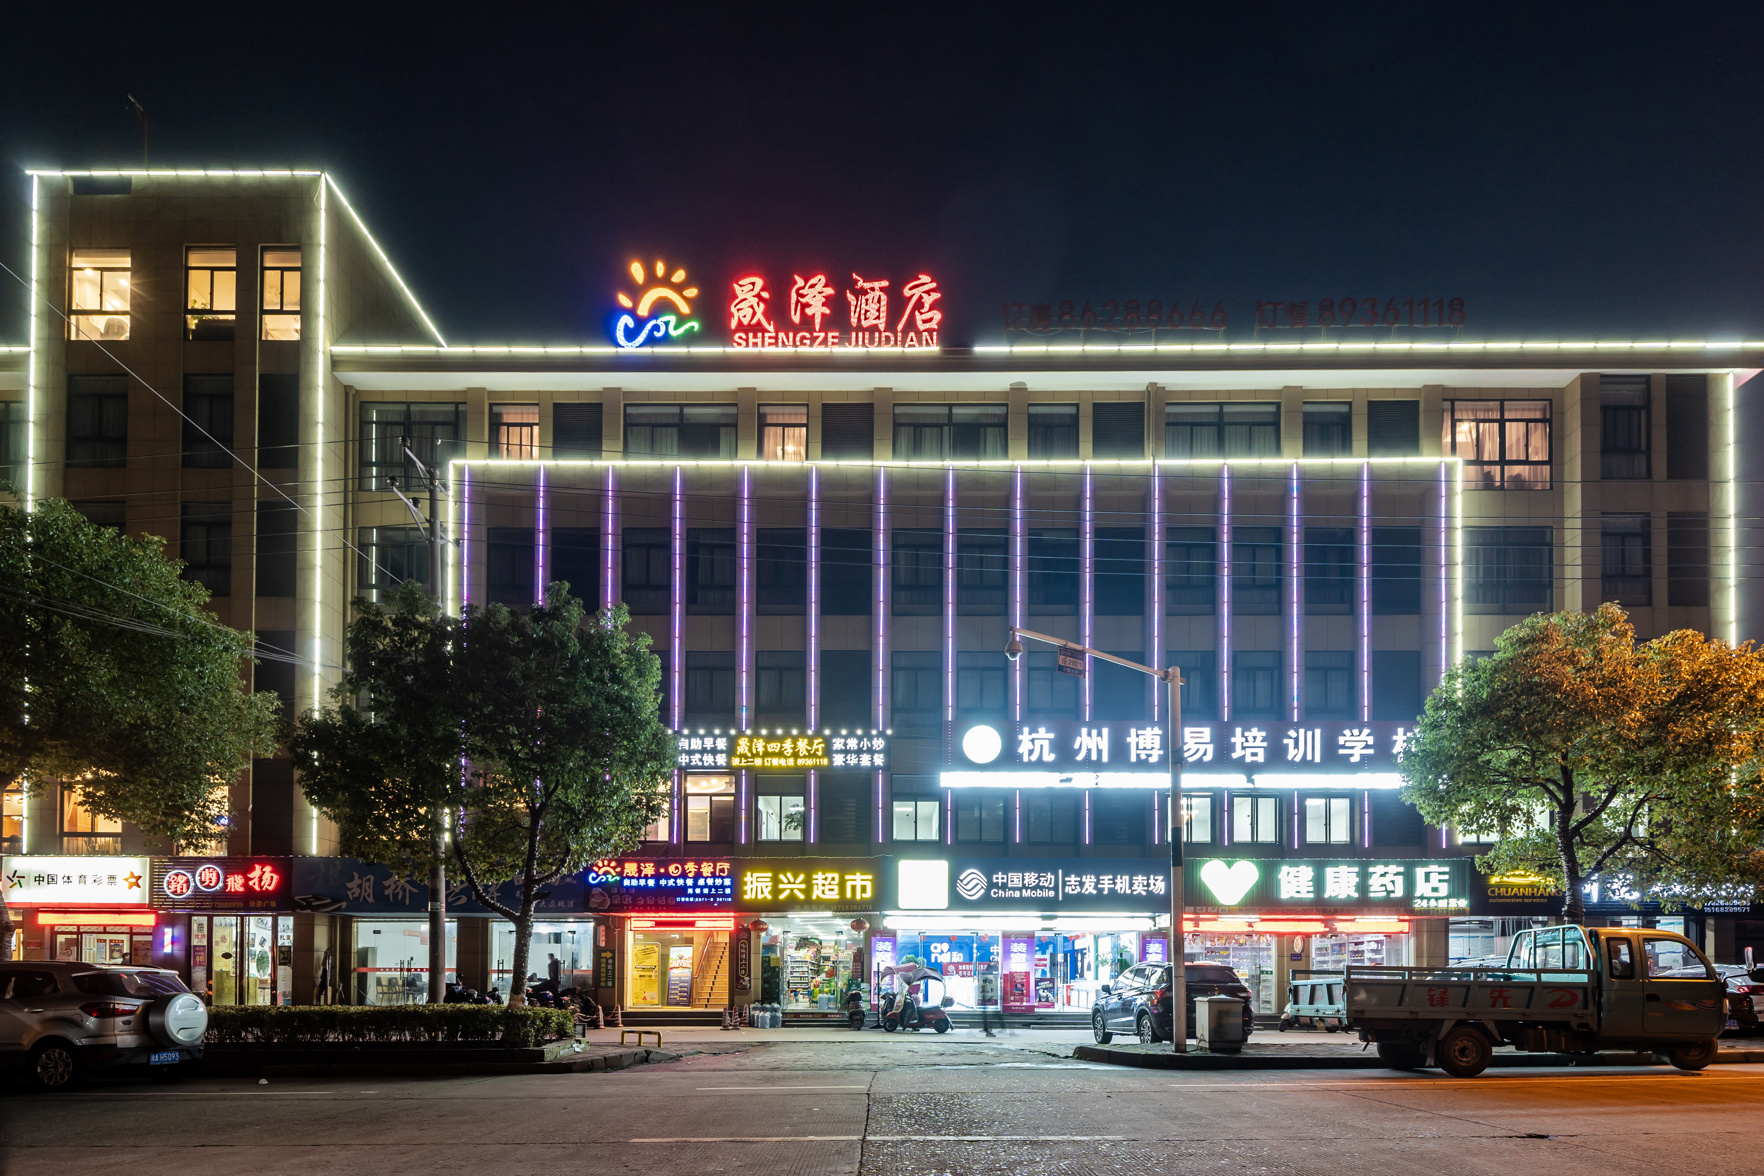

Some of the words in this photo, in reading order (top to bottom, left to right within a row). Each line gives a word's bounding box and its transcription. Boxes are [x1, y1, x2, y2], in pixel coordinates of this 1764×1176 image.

[730, 273, 943, 332] 晟泽酒店
[733, 332, 840, 349] SHENGZE
[845, 332, 938, 349] JIUDIAN
[736, 738, 825, 757] 晟泽四季餐厅
[832, 738, 884, 751] 家常小炒
[678, 753, 727, 767] 中式快餐
[764, 758, 794, 767] 订餐电话
[797, 757, 828, 767] 89361118
[833, 753, 884, 767] 豪华套餐
[33, 873, 118, 887] 中国体育彩票
[659, 879, 694, 887] 中式快餐
[743, 870, 873, 900] 振兴超市
[992, 871, 1055, 888] 中国移动
[1064, 874, 1166, 895] 志发手机卖场
[1278, 865, 1450, 899] 健康药店
[990, 888, 1021, 899] China
[1022, 888, 1055, 899] Mobile
[1488, 887, 1563, 897] CHUANHANG
